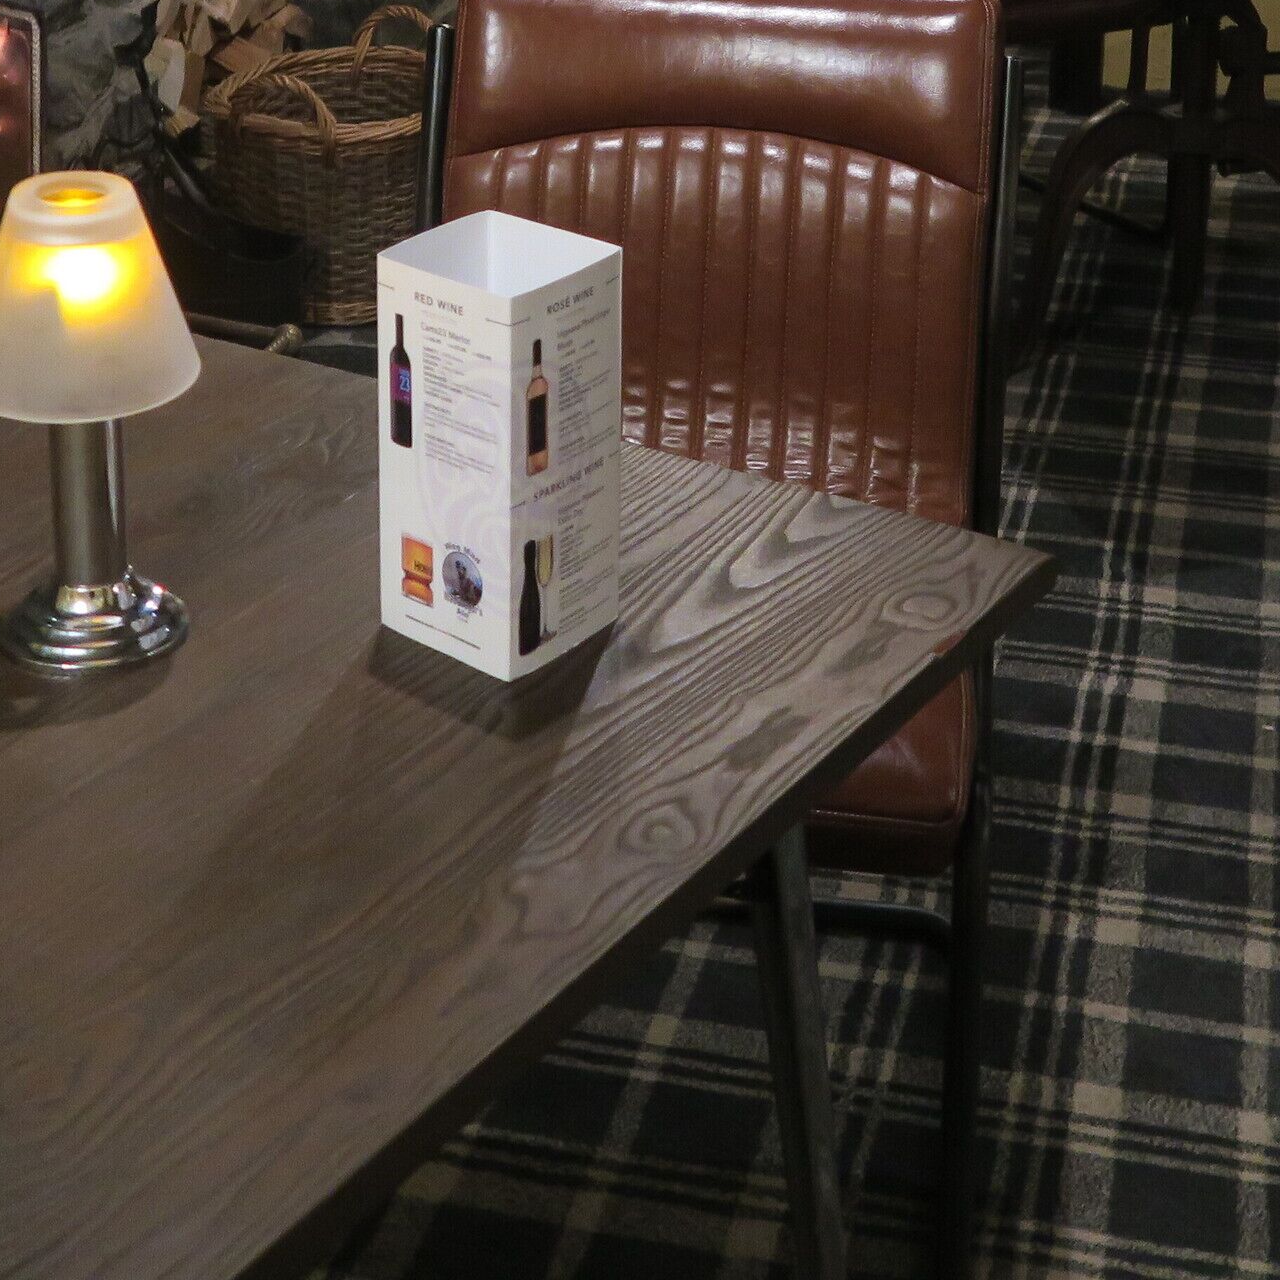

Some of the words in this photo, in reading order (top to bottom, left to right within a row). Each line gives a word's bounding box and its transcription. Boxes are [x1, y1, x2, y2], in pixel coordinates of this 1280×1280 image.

[414, 291, 433, 307] RED
[437, 299, 464, 317] WINE
[546, 296, 571, 314] ROSÉ
[572, 286, 594, 304] WINE
[399, 376, 411, 392] 23
[533, 469, 582, 503] SPARKLING
[583, 456, 605, 476] WINE
